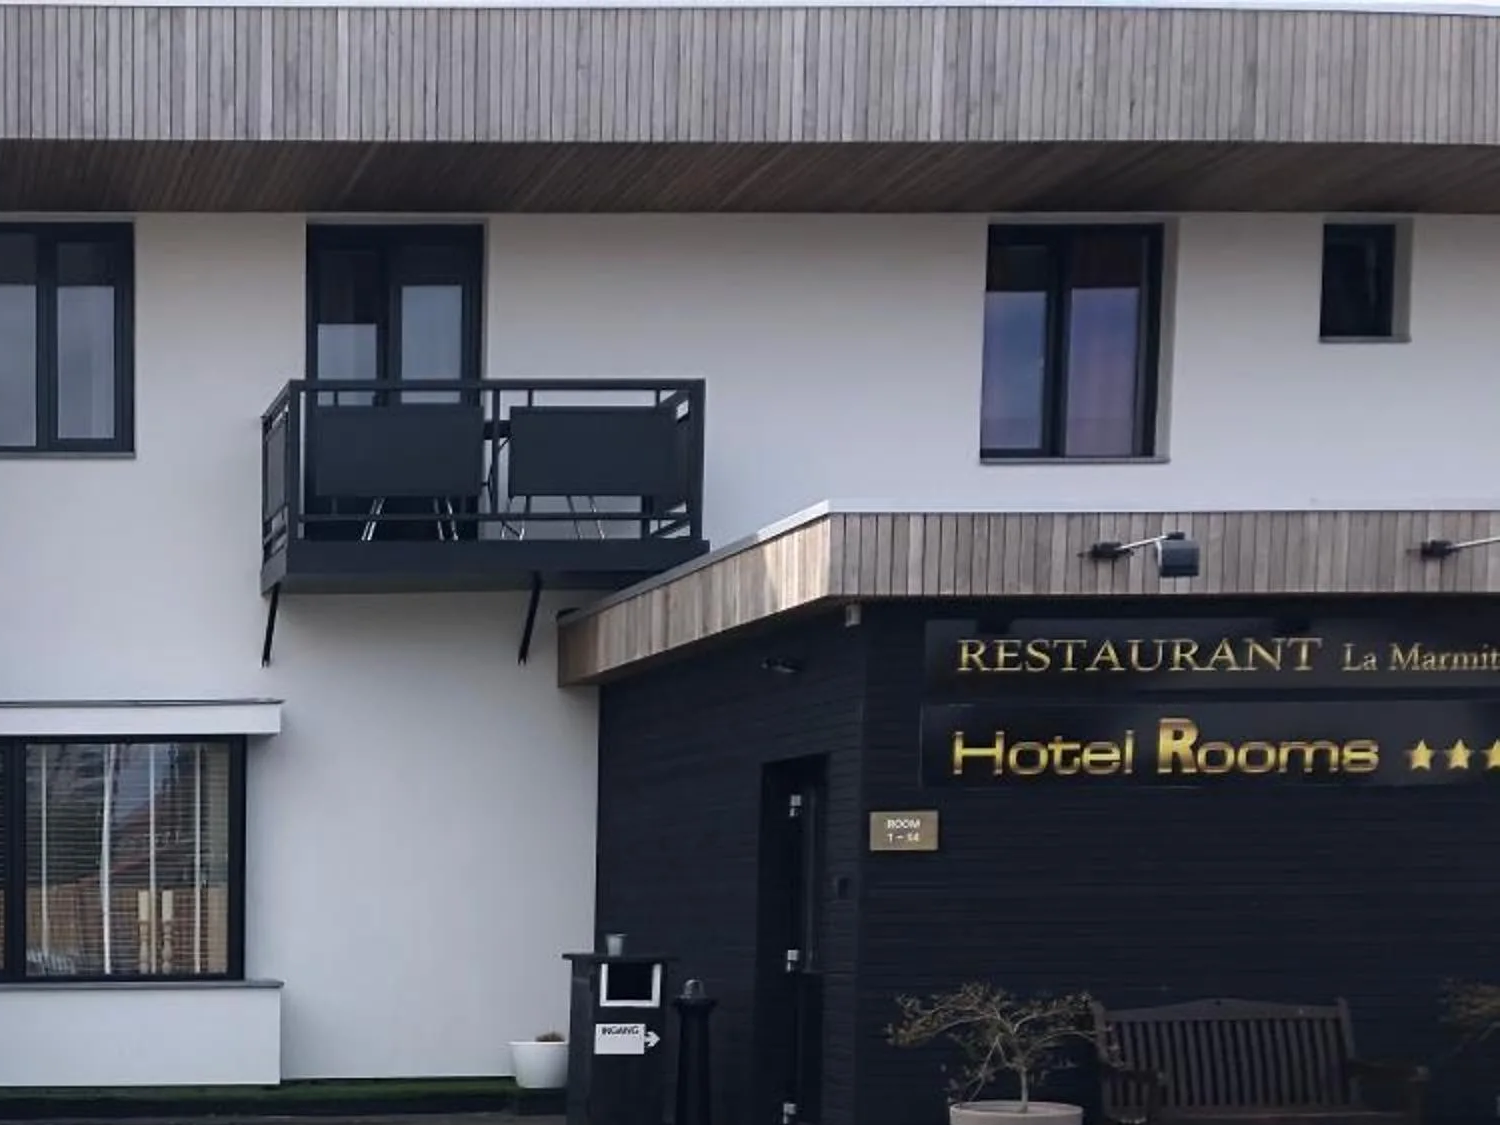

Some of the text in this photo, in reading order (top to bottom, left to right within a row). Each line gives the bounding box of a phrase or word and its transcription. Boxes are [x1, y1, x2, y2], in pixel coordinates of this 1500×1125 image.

[957, 637, 1323, 673] RESTAURANT
[1342, 642, 1378, 671] La
[951, 716, 1380, 776] Hotel Rooms
[887, 819, 920, 829] ROOM
[602, 1026, 639, 1035] INGANG
